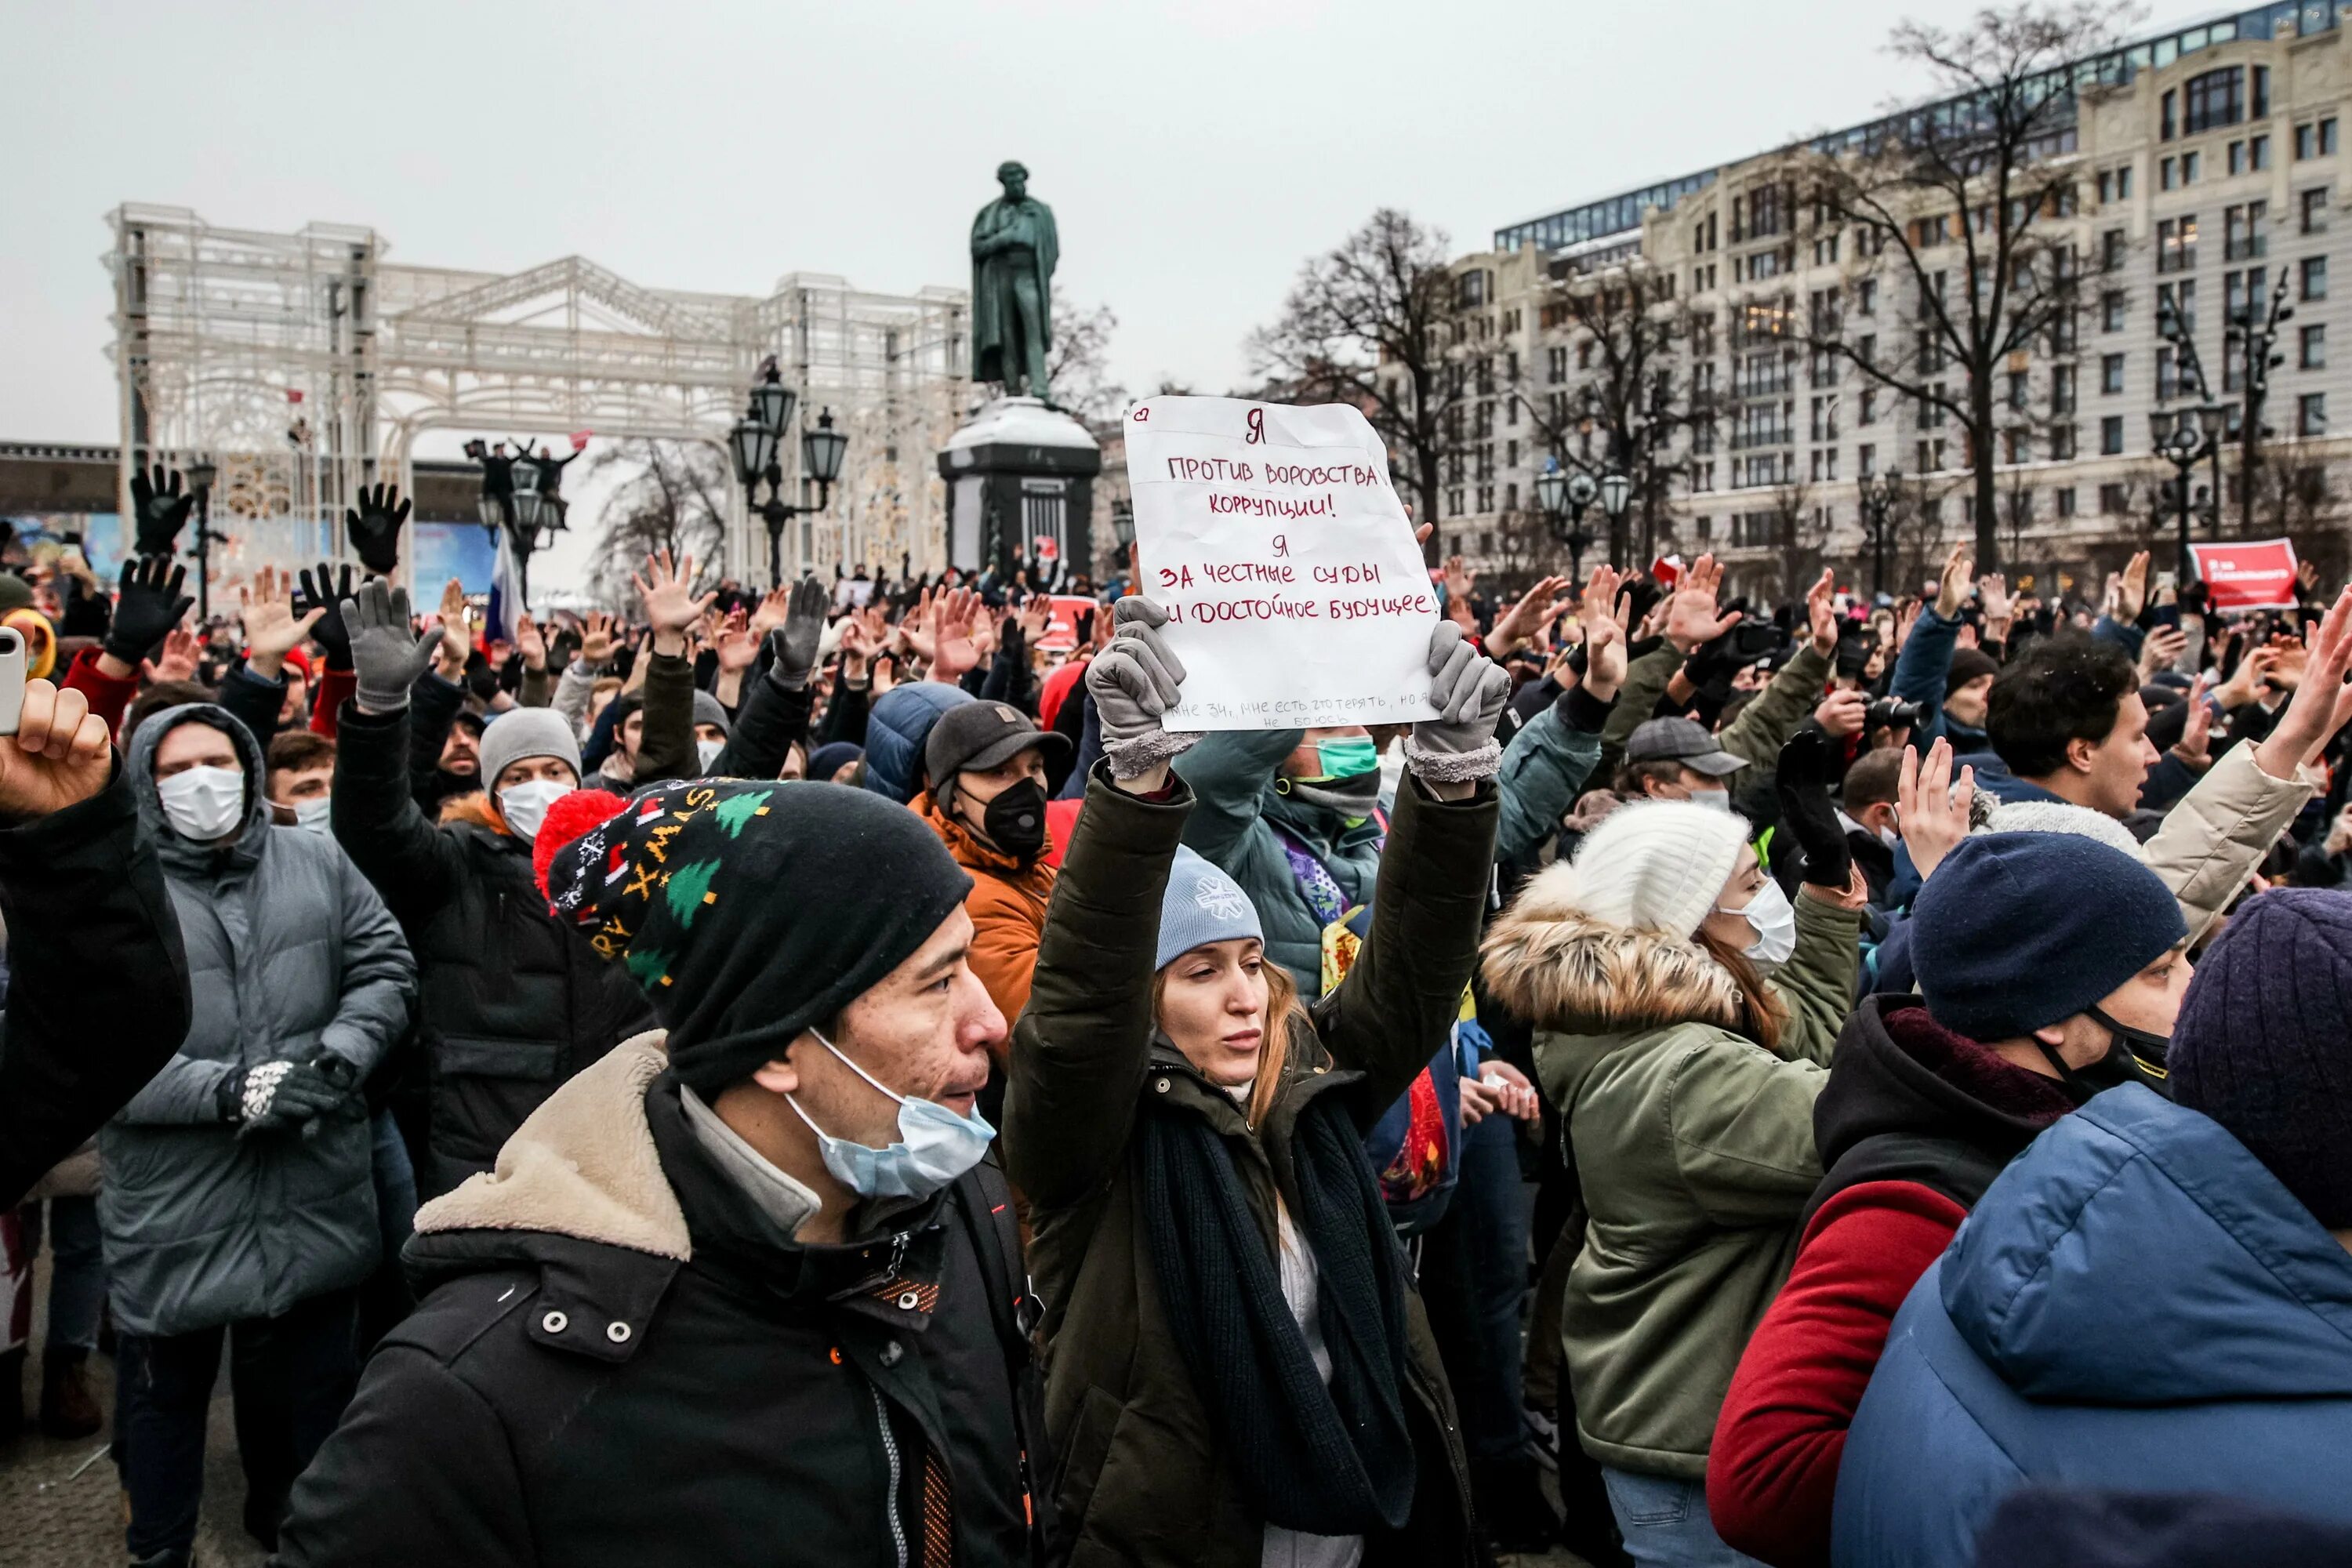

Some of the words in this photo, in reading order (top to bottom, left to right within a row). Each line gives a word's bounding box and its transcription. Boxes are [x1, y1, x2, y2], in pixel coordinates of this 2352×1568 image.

[1245, 407, 1267, 445] Я
[1167, 457, 1254, 482] ПРОТИВ
[1265, 462, 1378, 487] ВОРОВСТВА
[1208, 493, 1337, 520] КОРРУПЦИИ!
[1272, 534, 1290, 558] Я
[1159, 564, 1195, 590] ЗА
[1313, 562, 1381, 584] СУДЫ
[1165, 603, 1183, 624] И
